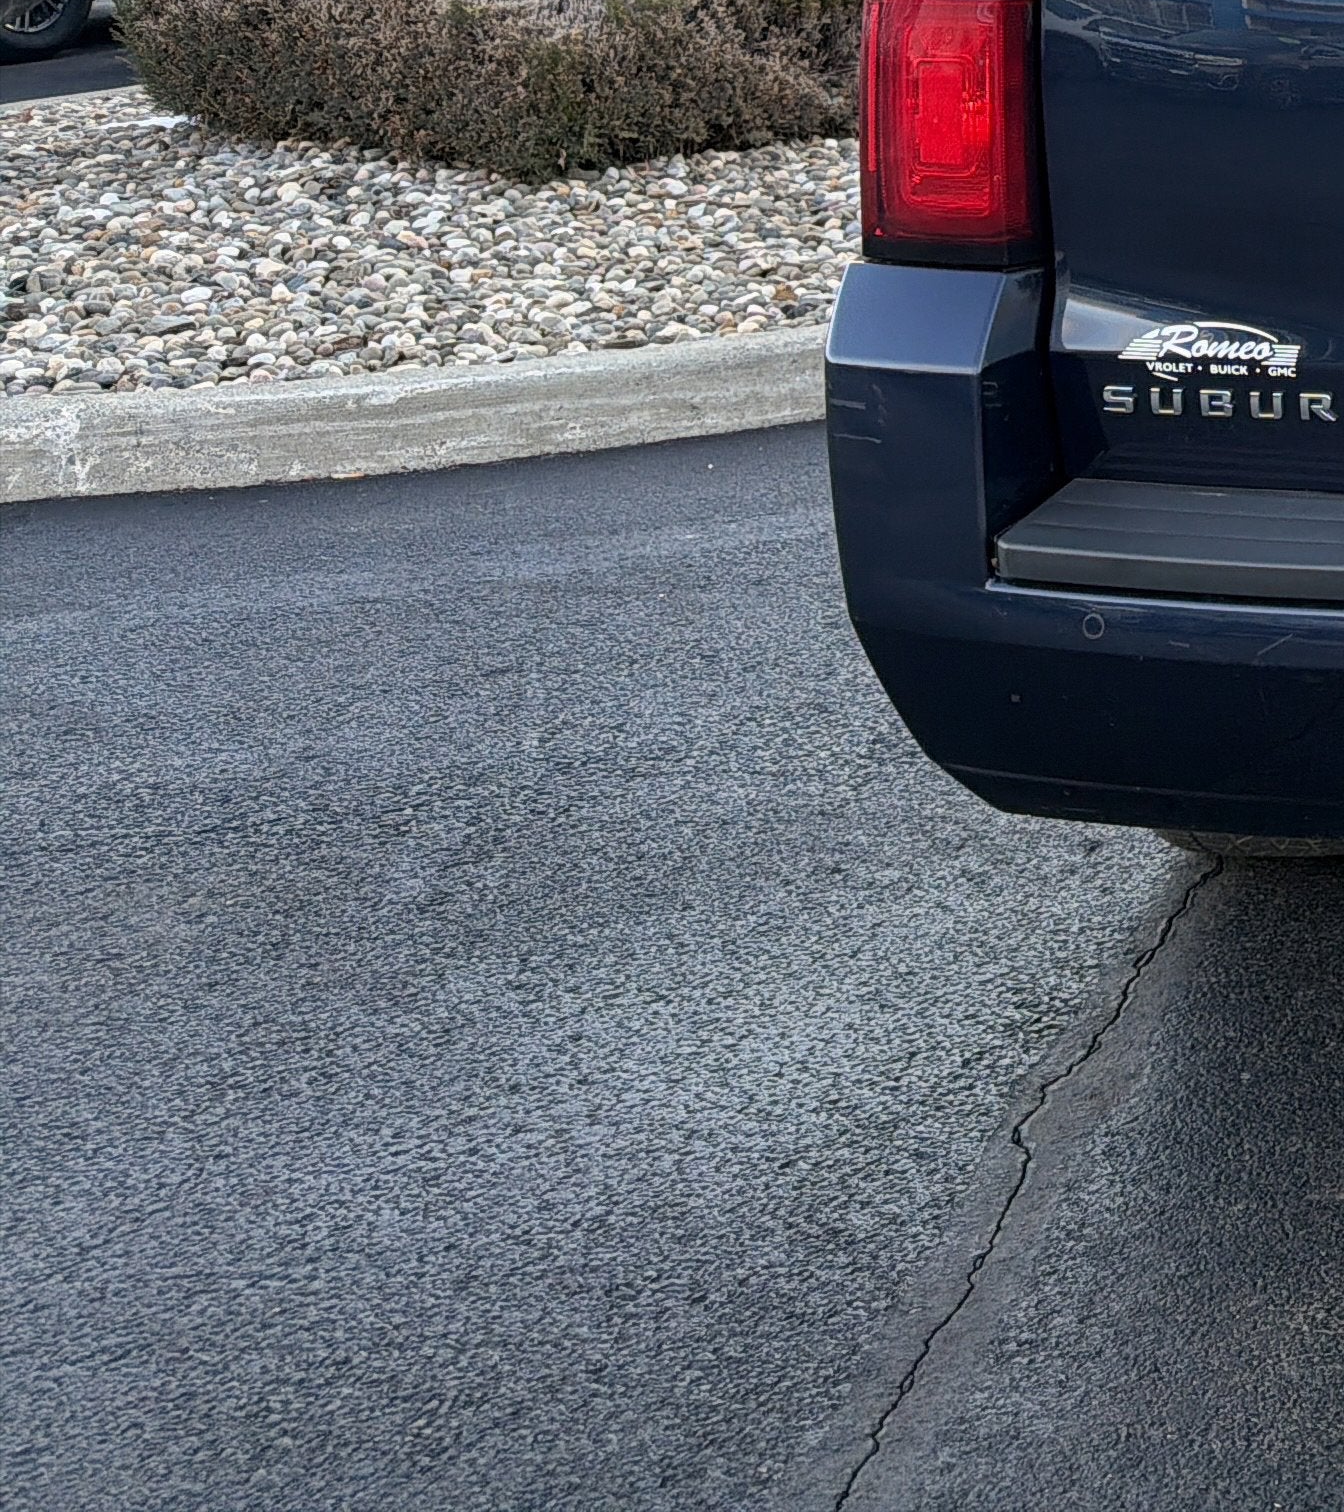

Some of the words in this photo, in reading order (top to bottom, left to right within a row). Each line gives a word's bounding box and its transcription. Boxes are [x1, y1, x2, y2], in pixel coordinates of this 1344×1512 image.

[1158, 323, 1274, 360] Romeo
[1209, 364, 1249, 376] BUICK
[1267, 366, 1298, 378] GMC
